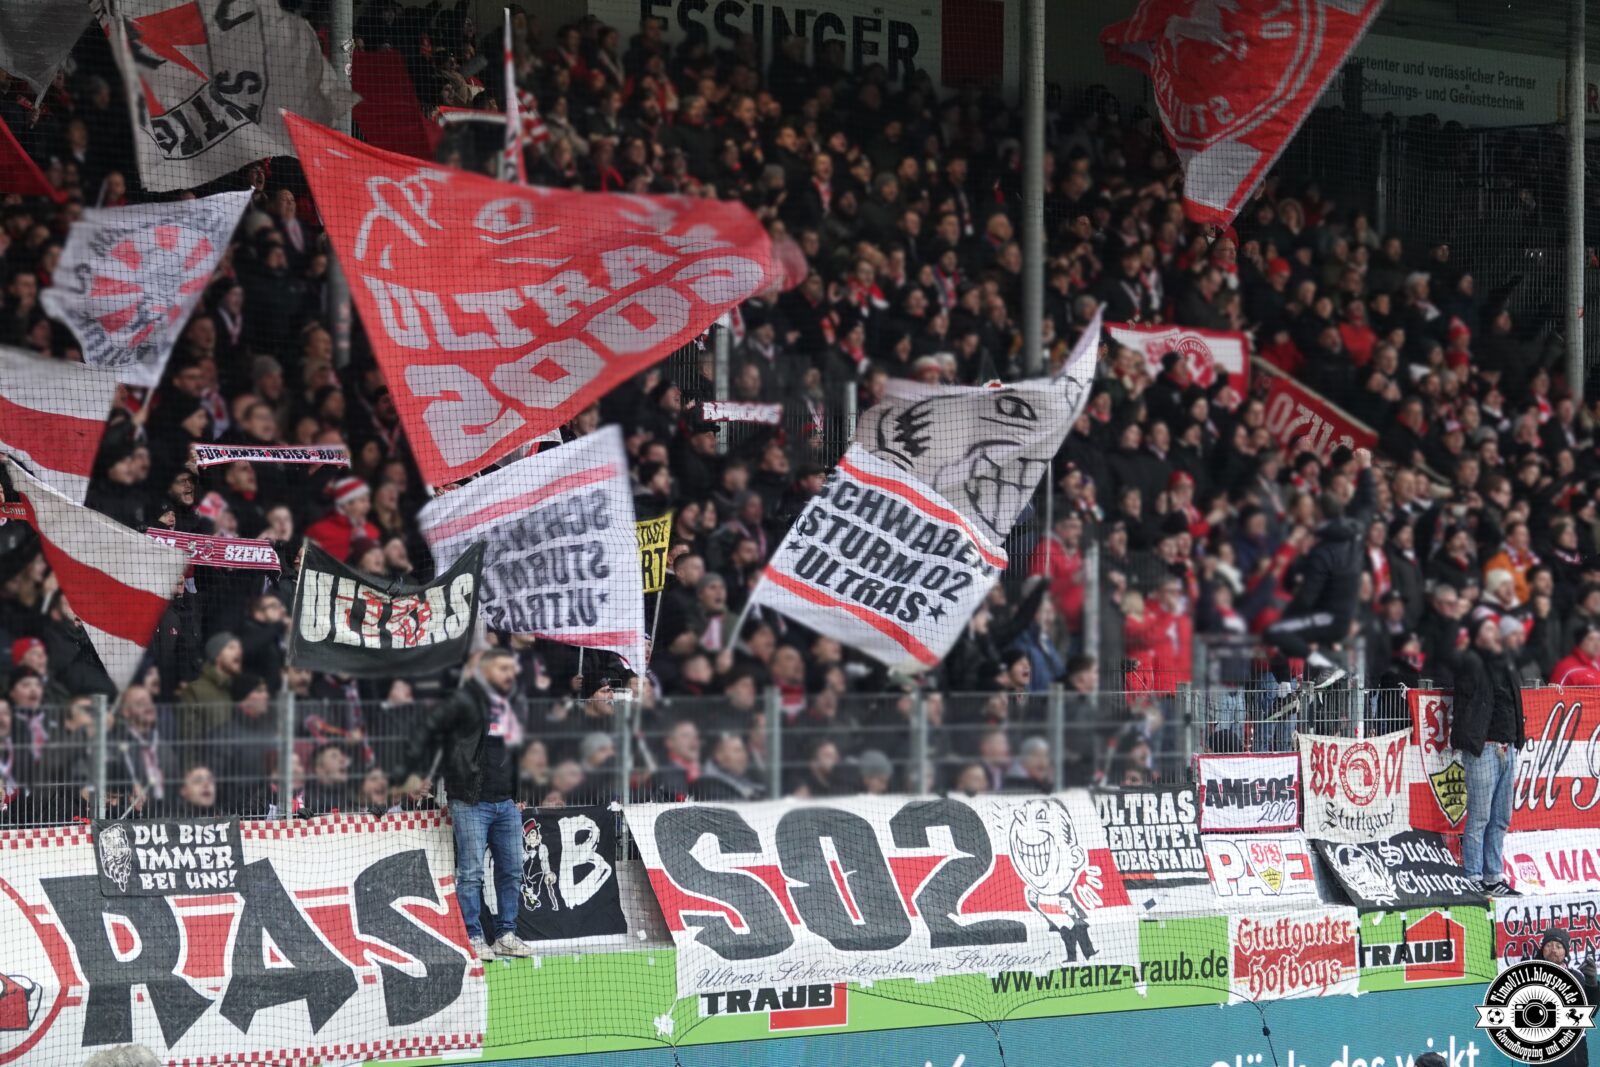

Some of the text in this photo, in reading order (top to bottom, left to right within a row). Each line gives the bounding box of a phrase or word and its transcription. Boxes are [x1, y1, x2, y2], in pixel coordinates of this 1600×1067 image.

[1403, 62, 1424, 76] und
[1427, 65, 1495, 84] verlässlicher
[1498, 71, 1537, 91] Partner
[1361, 77, 1423, 99] Schalungs-
[1426, 87, 1447, 101] und
[1450, 86, 1525, 112] Gerüsttechnik
[800, 505, 923, 584] STURM
[795, 544, 928, 623] ULTRAS
[1256, 800, 1297, 824] 2010
[1319, 801, 1395, 838] Stuttgart
[132, 821, 231, 846] DU BIST
[135, 845, 235, 871] IMMER
[139, 869, 238, 890] BEI UNS!
[696, 967, 764, 989] Ultras
[947, 947, 1052, 974] Stuttgart
[1360, 941, 1455, 968] TRAUB
[1248, 955, 1342, 1002] Hofboys
[700, 983, 834, 1016] TRAUB
